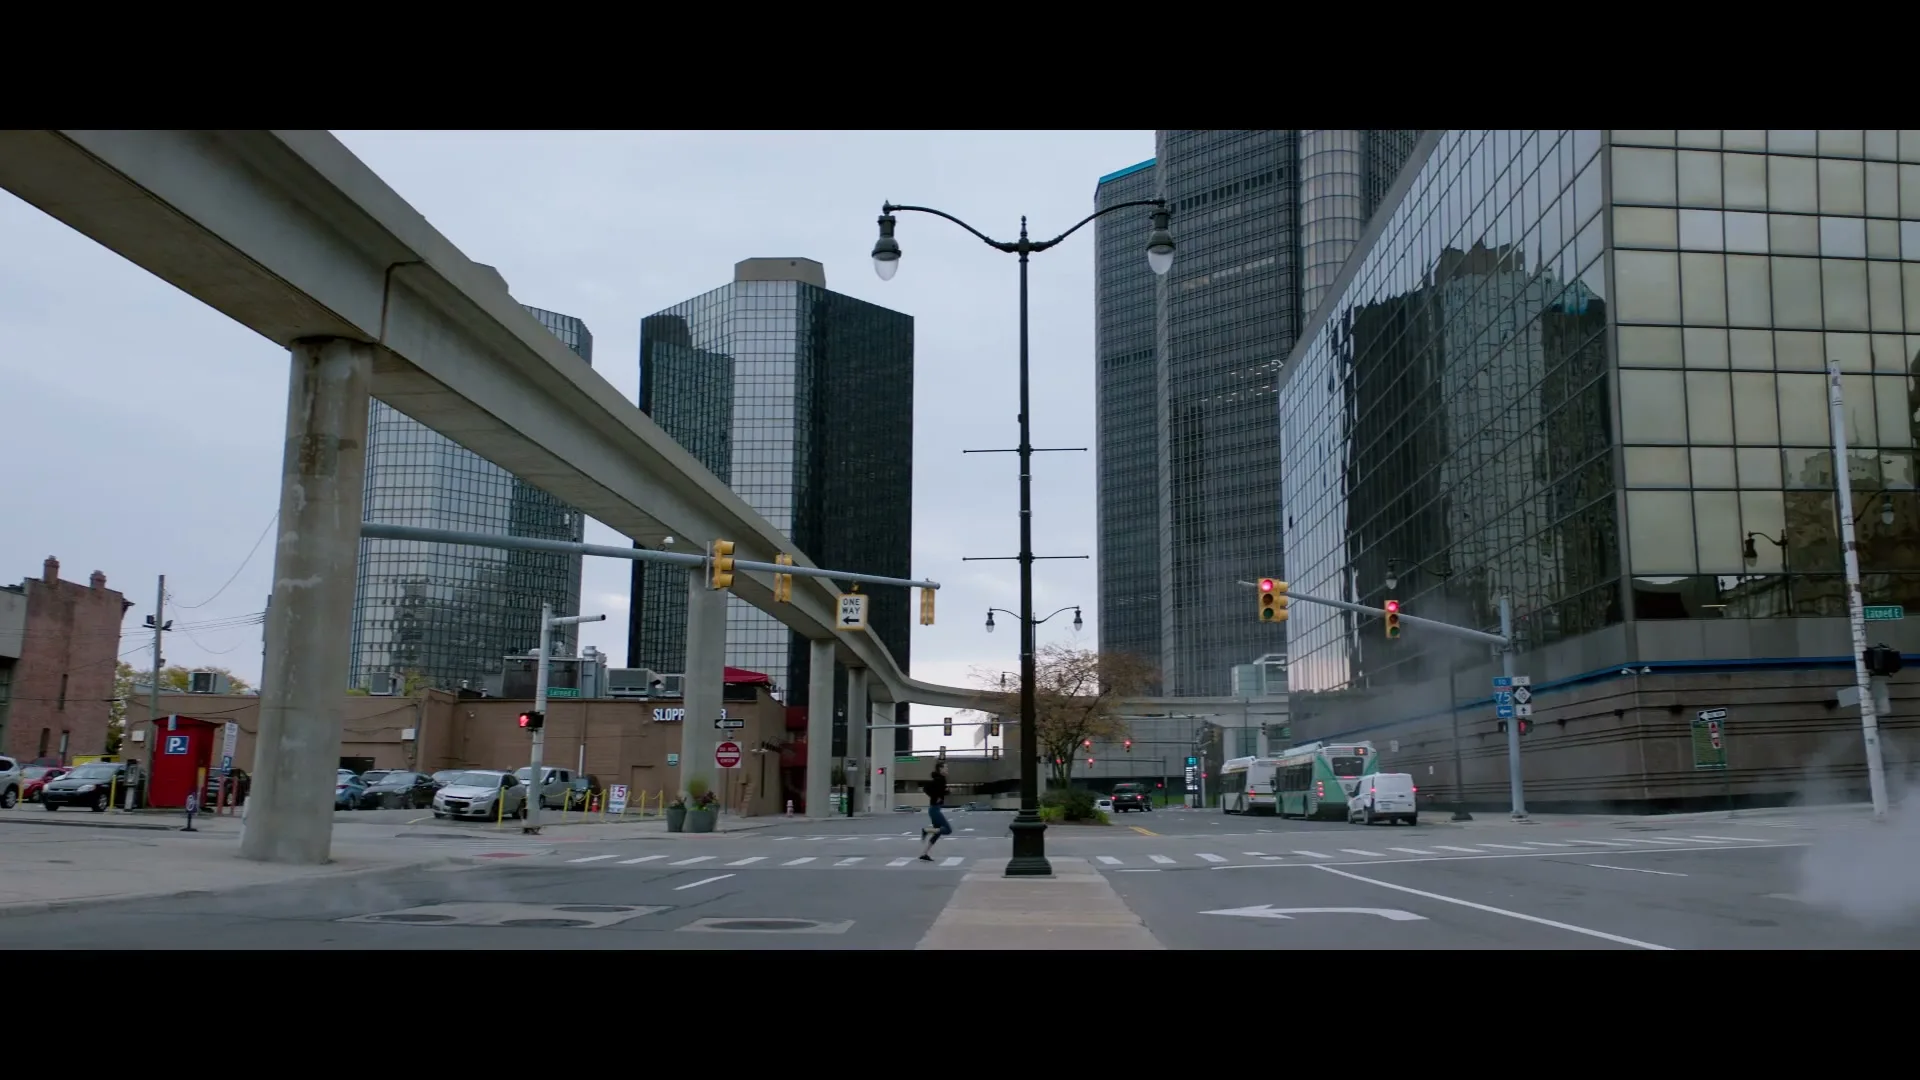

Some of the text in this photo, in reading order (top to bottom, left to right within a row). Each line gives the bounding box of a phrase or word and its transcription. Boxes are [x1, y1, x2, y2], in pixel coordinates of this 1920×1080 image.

[843, 598, 860, 606] ONE
[842, 607, 860, 615] WAY
[1894, 608, 1900, 618] E
[1497, 691, 1511, 702] 75
[653, 708, 685, 721] SLOPP
[169, 738, 181, 752] P
